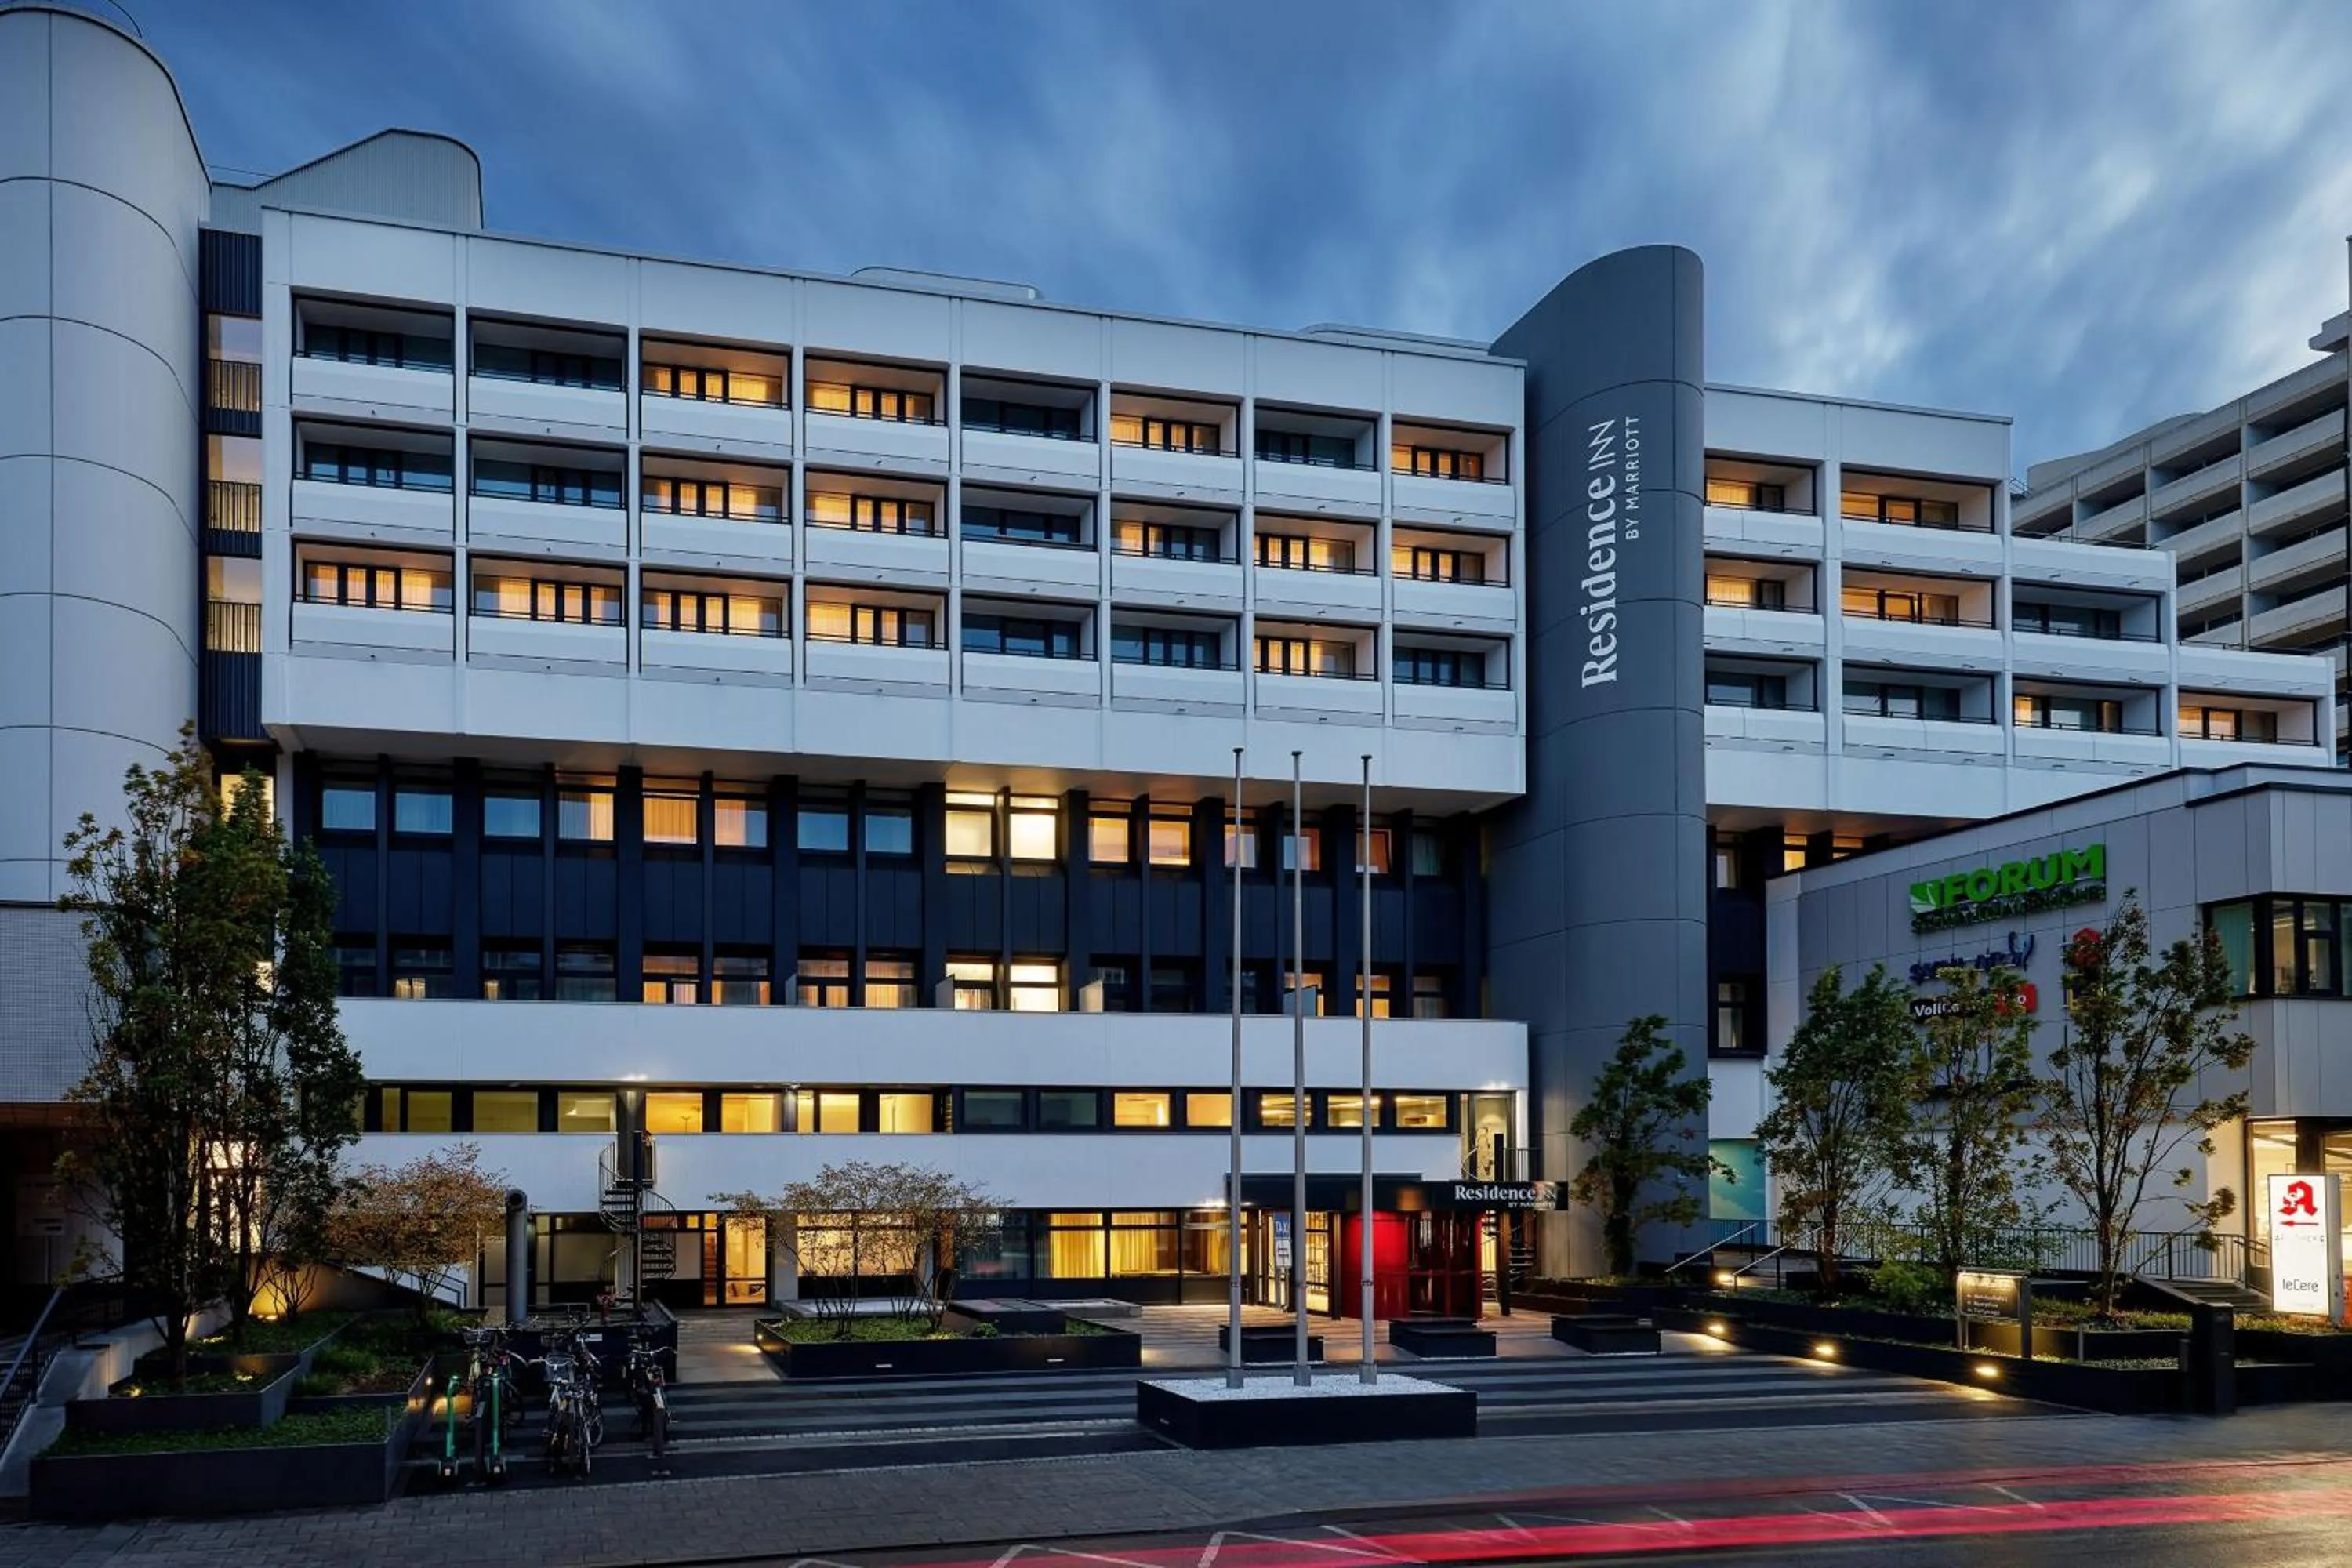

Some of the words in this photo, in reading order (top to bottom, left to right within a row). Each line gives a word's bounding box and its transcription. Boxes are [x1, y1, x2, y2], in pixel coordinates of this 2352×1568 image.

[1588, 419, 1616, 471] INN
[1625, 416, 1640, 510] MARRIOTT
[1625, 517, 1639, 539] BY
[1580, 474, 1617, 688] Residence
[1943, 843, 2107, 908] FORUM
[1454, 1185, 1536, 1200] Residence
